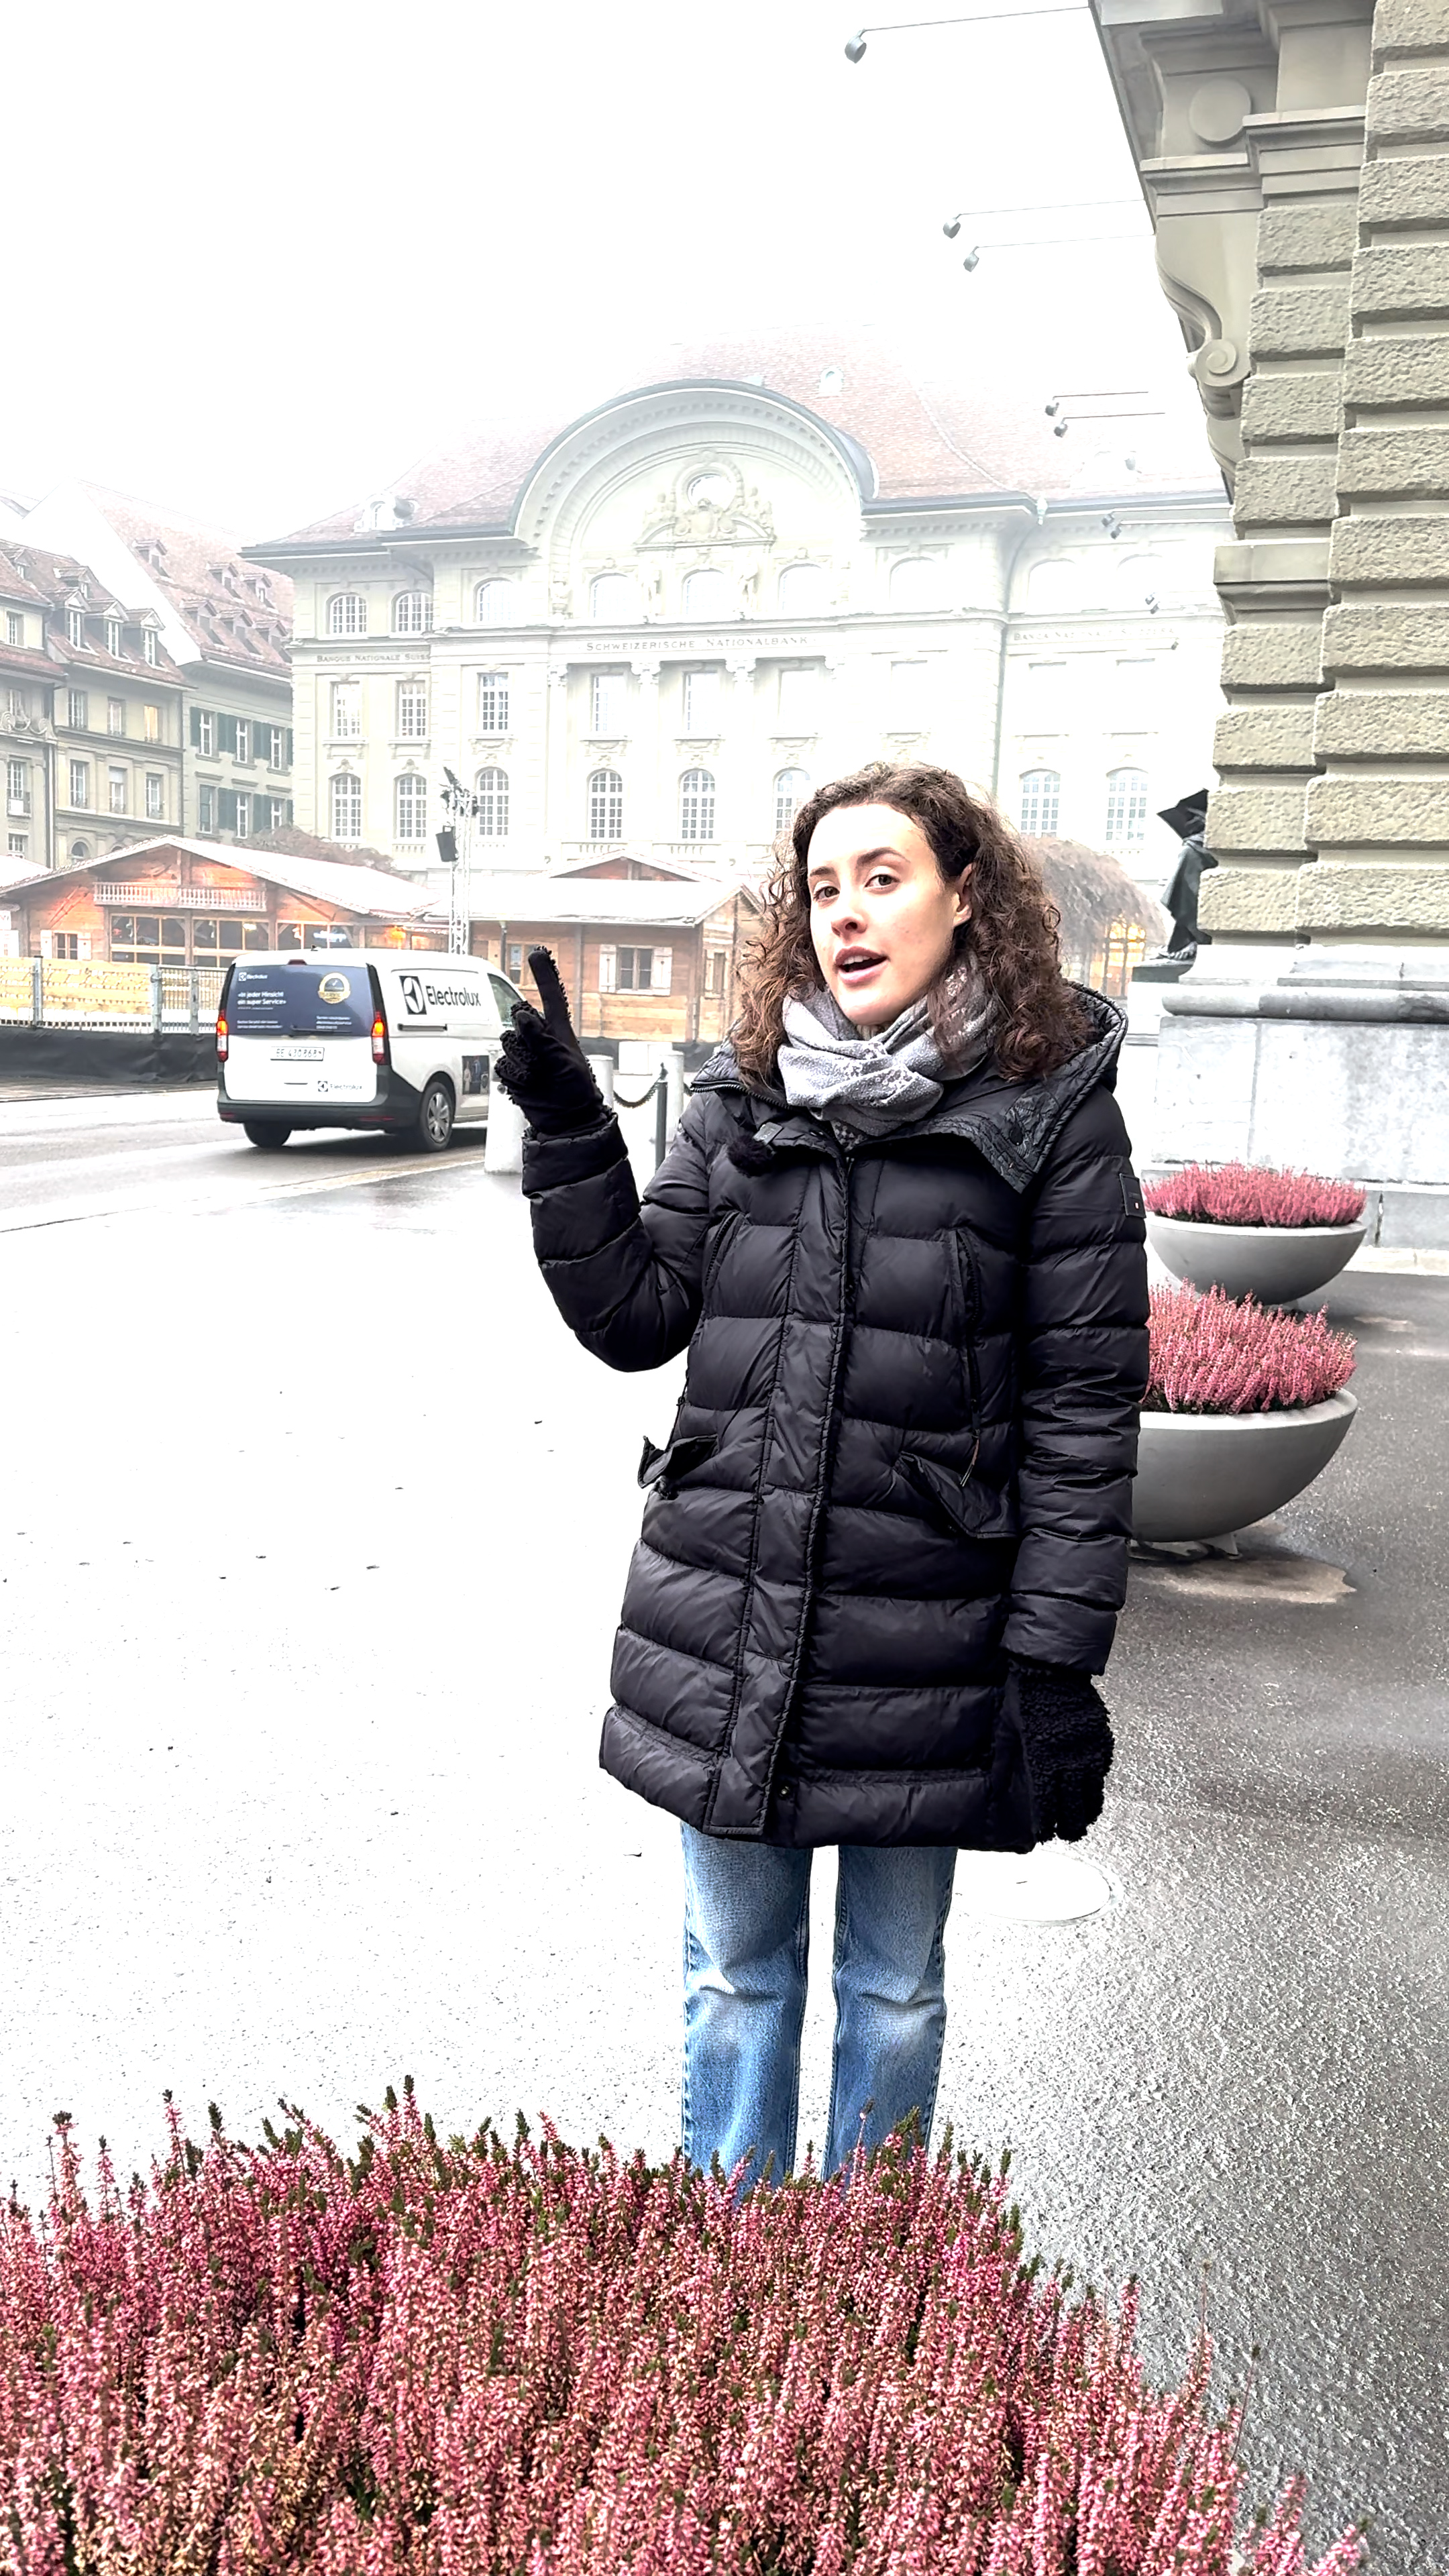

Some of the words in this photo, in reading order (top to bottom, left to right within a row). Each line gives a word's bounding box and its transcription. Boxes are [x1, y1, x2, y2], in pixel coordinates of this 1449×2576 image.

[586, 641, 695, 651] SCHWEIZERISCHE
[706, 637, 808, 647] NATIONALBANK
[425, 985, 482, 1006] Electrolux
